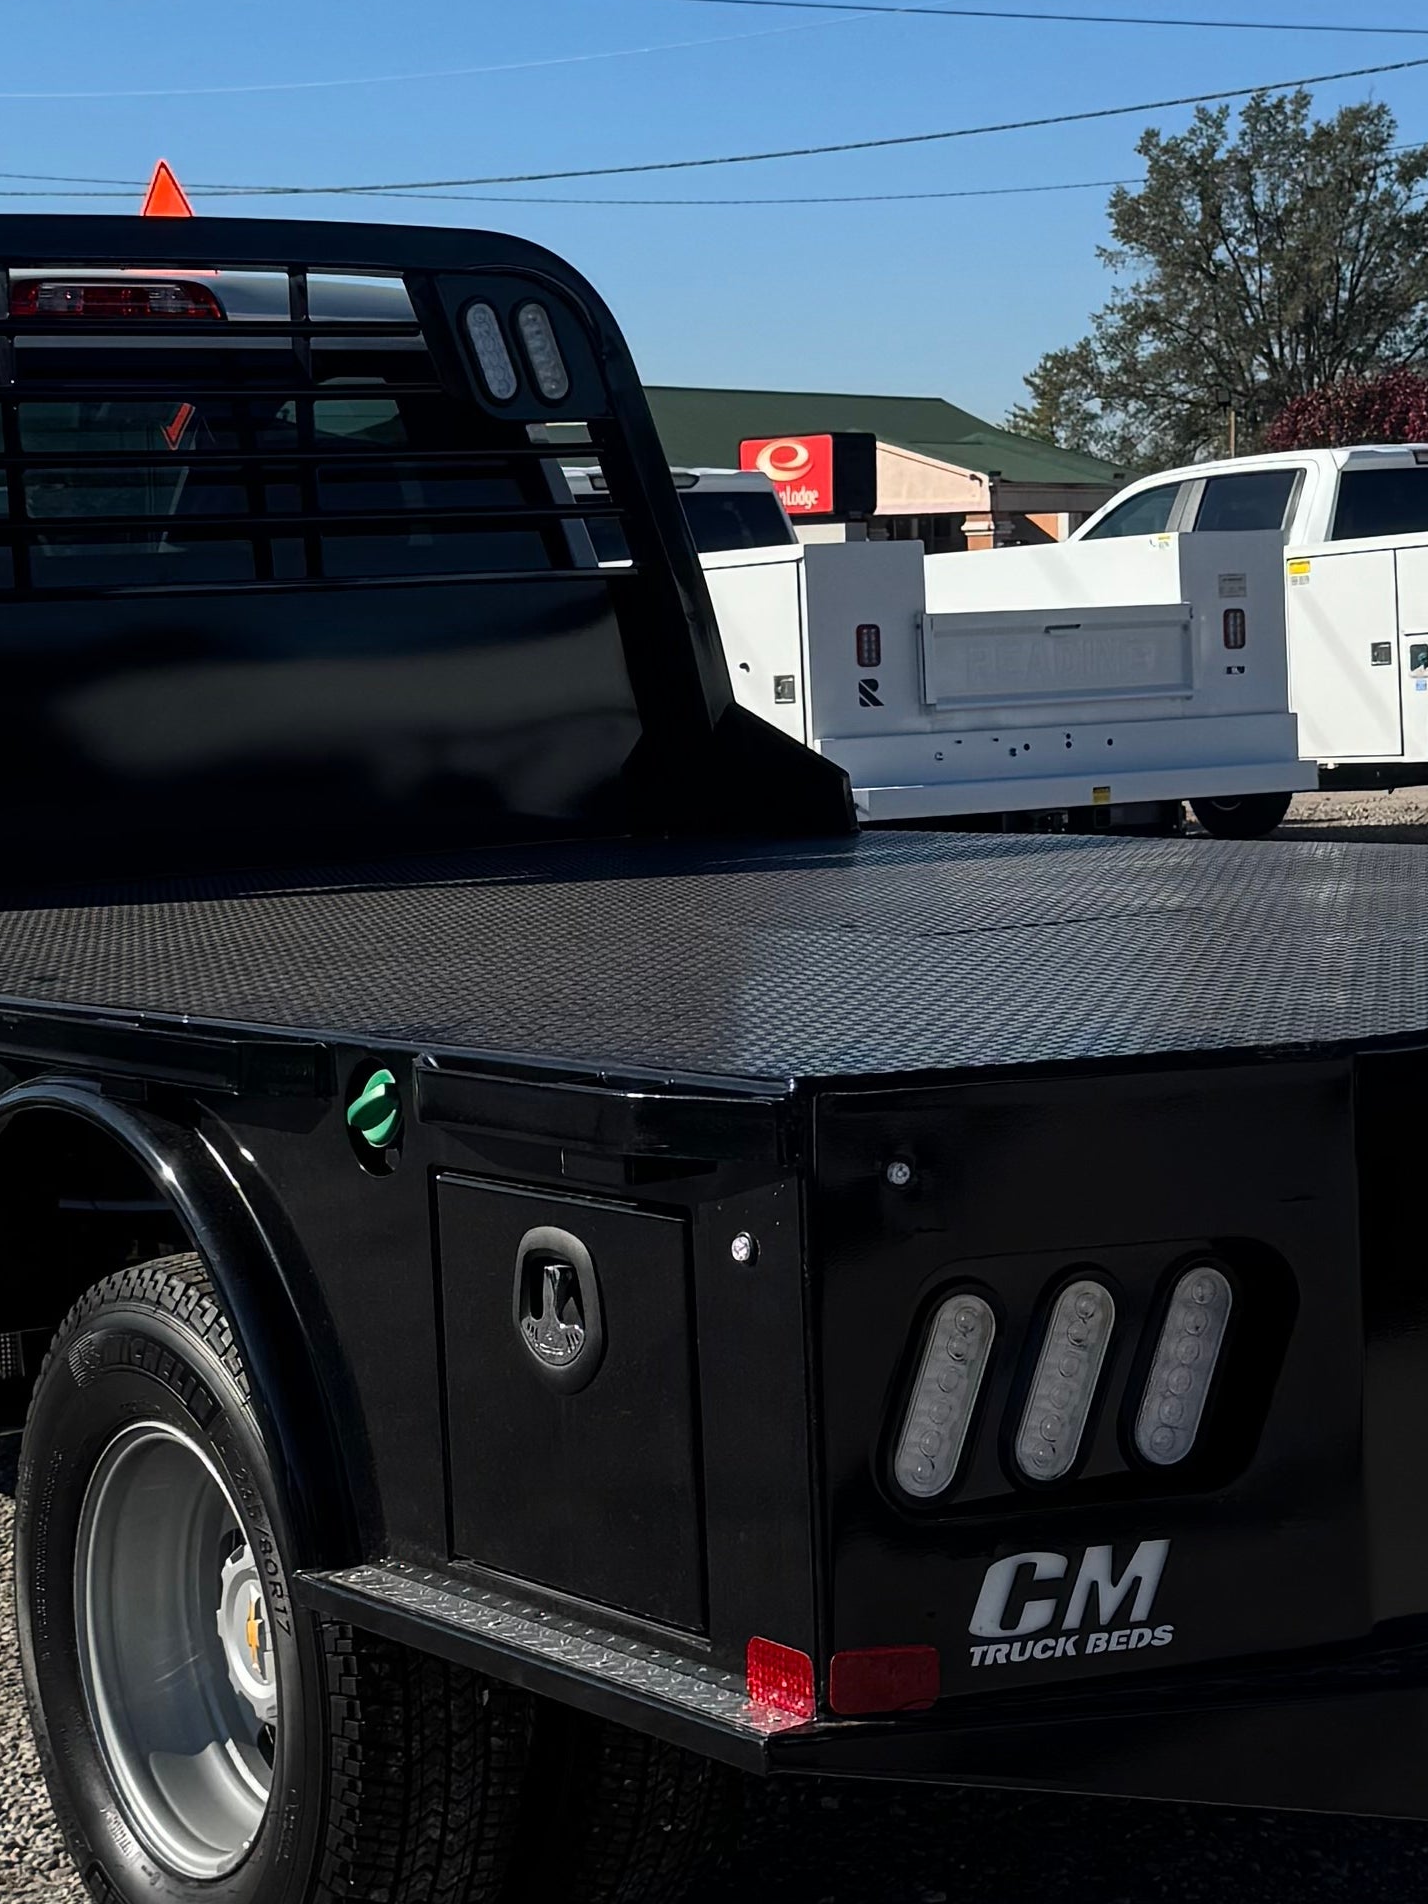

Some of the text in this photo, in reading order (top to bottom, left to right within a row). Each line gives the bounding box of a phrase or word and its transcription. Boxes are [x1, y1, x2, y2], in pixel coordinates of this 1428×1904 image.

[103, 1334, 216, 1423] MICHELIN
[969, 1539, 1171, 1638] CM
[969, 1624, 1175, 1667] TRUCK BEDS
